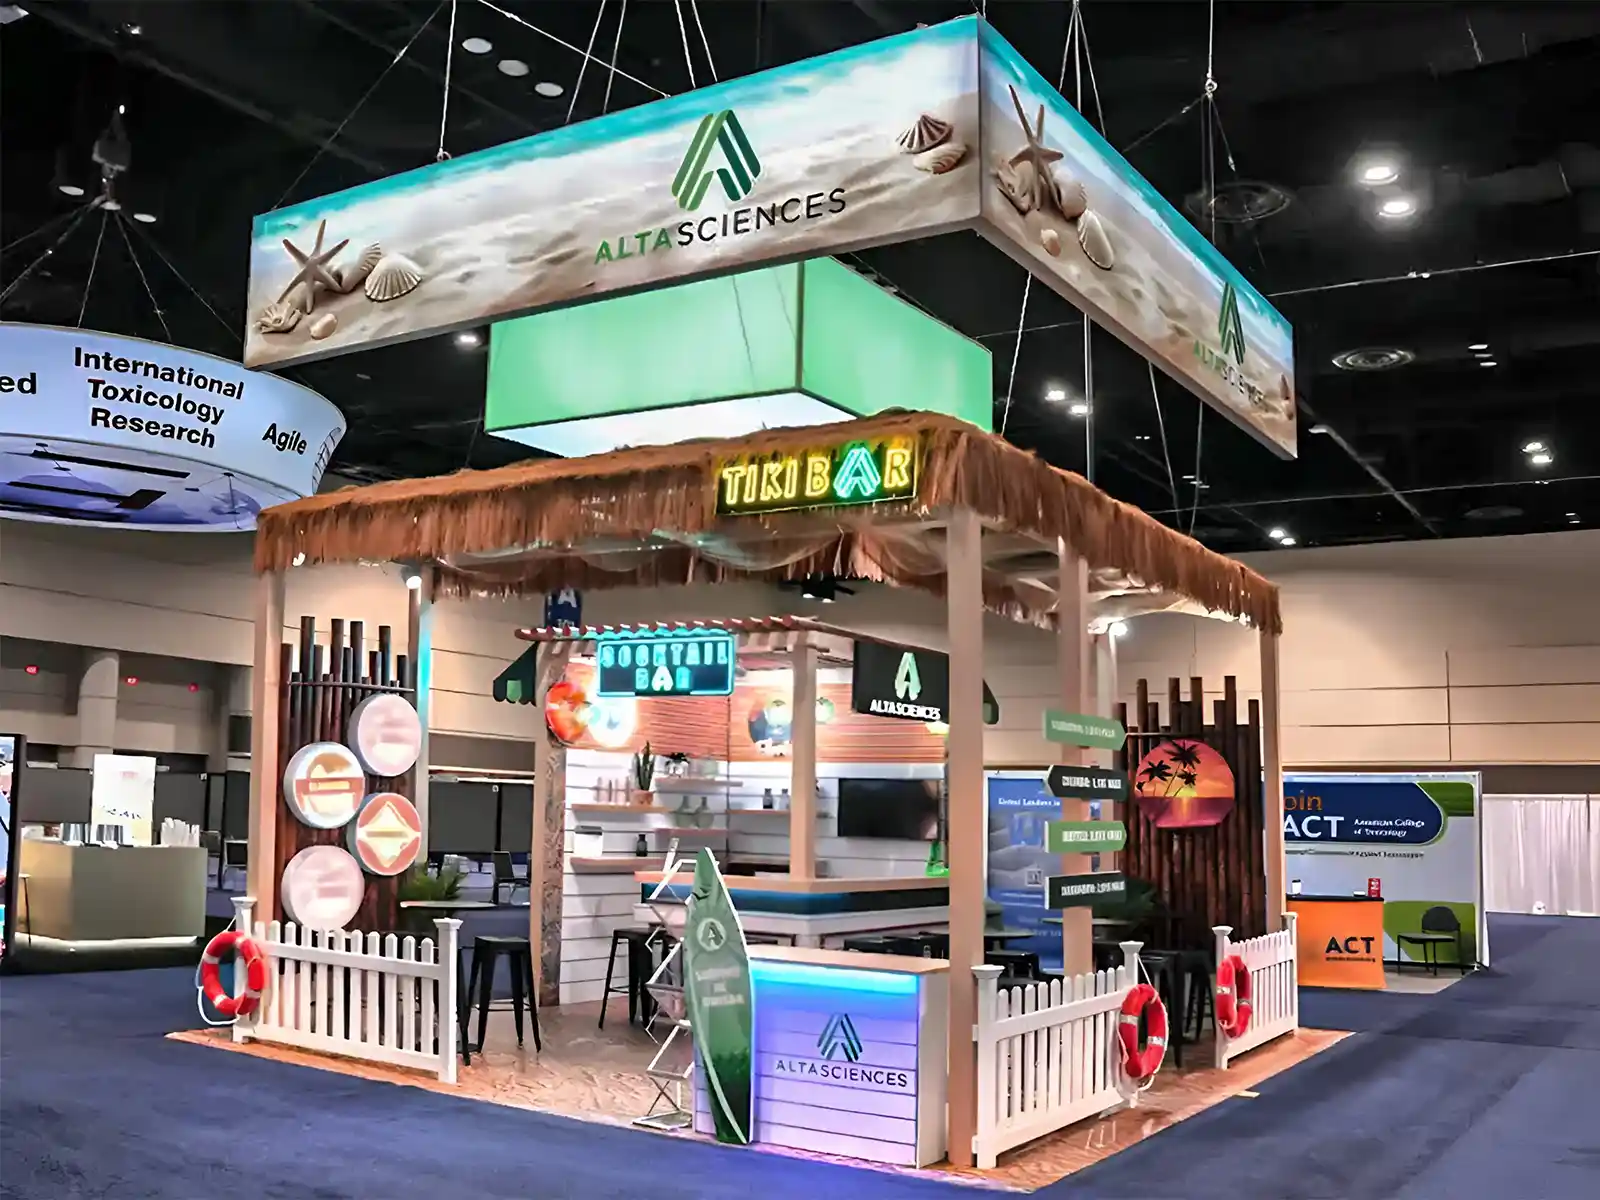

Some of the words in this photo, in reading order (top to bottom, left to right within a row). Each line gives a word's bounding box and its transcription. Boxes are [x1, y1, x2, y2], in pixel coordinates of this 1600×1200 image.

[594, 187, 847, 265] ALTASCIENCES
[74, 346, 244, 400] International
[87, 378, 225, 425] Toxicology
[90, 407, 216, 449] Research
[262, 422, 308, 456] Agile
[721, 456, 799, 505] TIKI
[804, 446, 912, 500] BAR
[869, 699, 941, 720] ALTASCIENCES
[1284, 789, 1322, 811] oin
[1283, 814, 1345, 838] ACT
[1325, 936, 1375, 954] ACT
[776, 1059, 908, 1088] ALTASCIENCES
